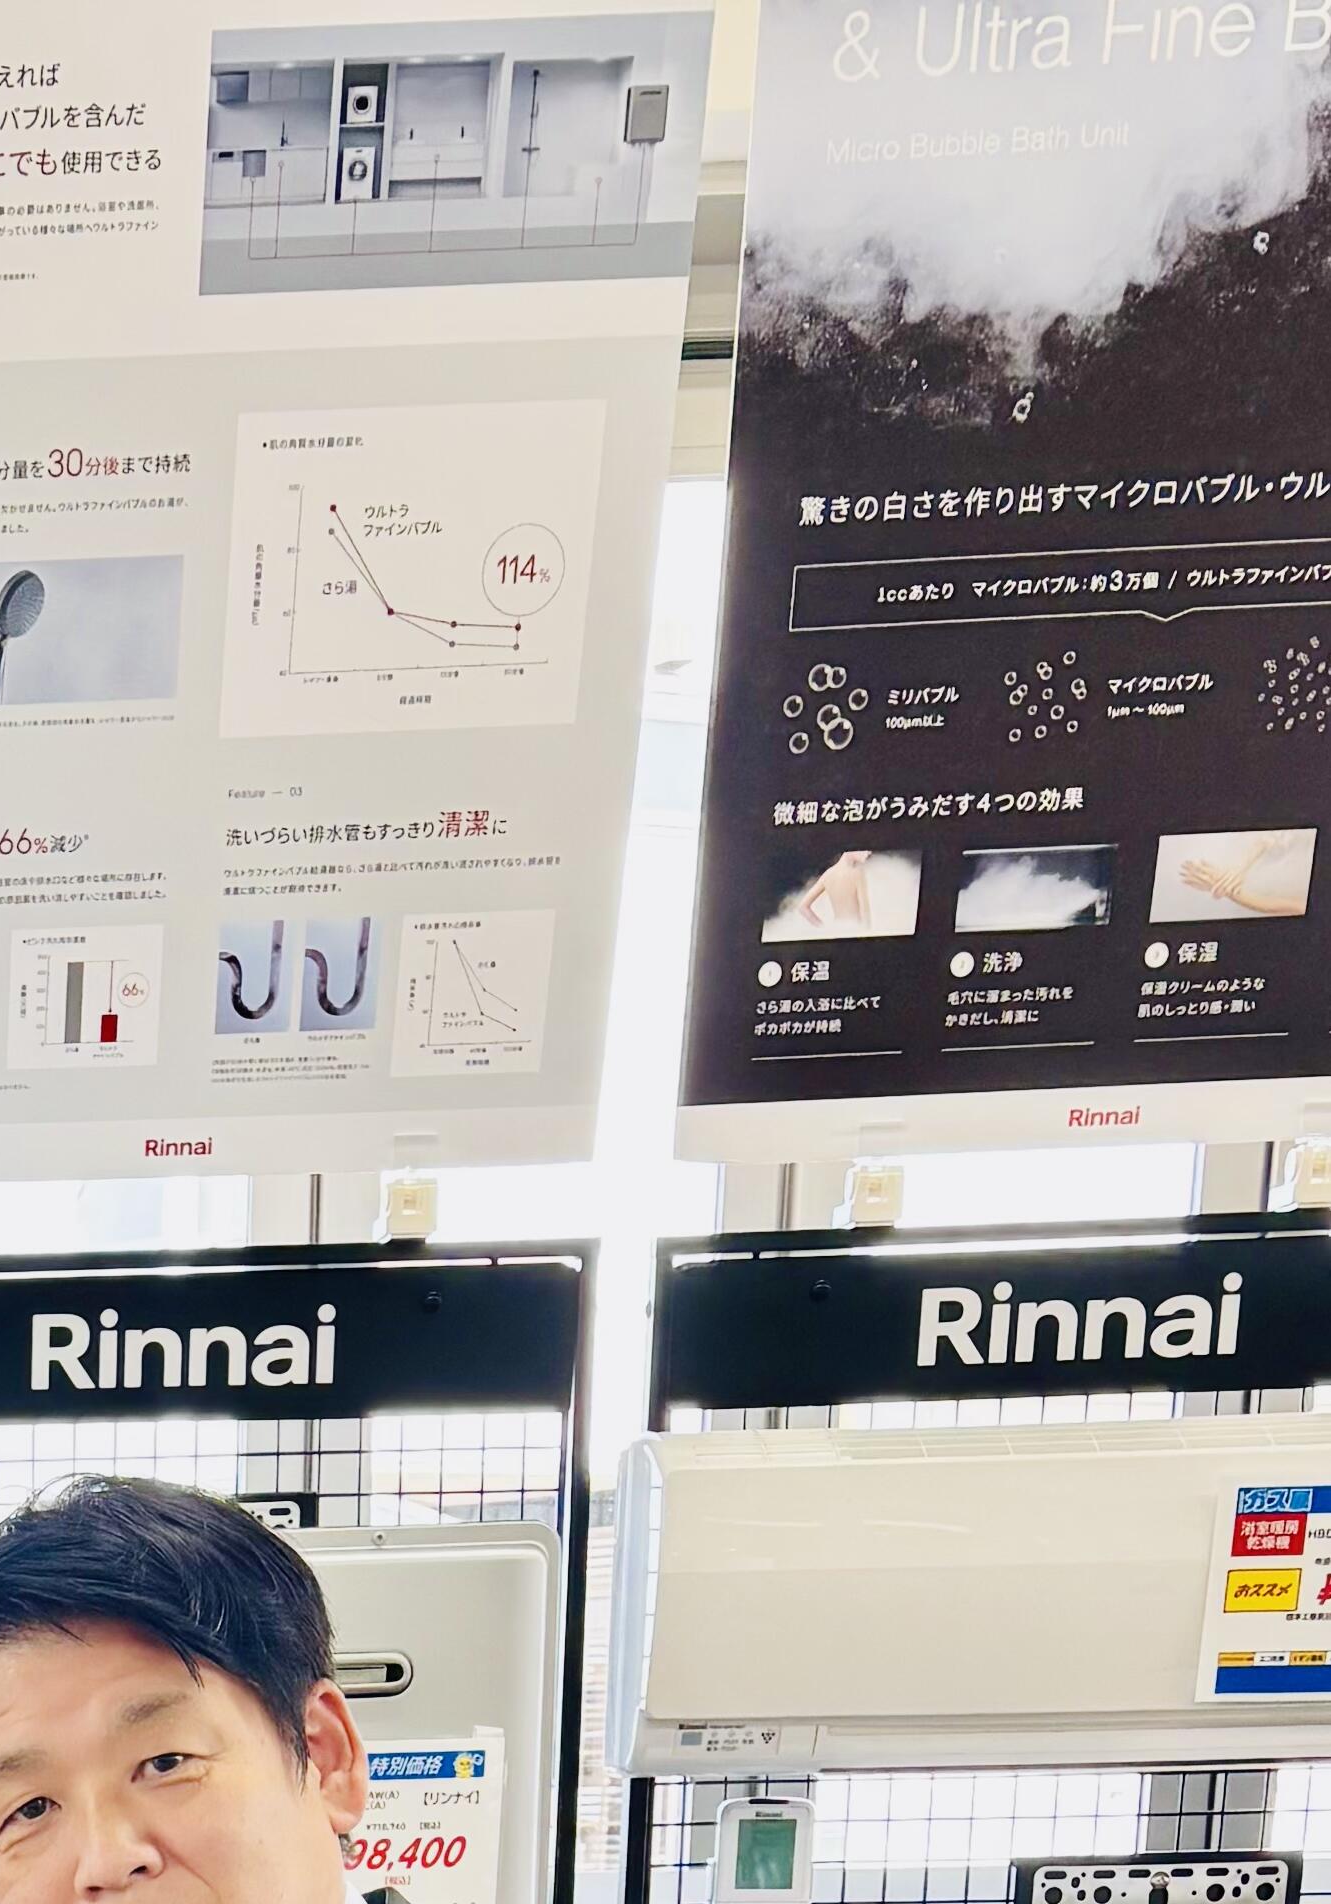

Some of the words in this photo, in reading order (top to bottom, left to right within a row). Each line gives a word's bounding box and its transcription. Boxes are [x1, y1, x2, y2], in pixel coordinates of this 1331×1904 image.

[833, 10, 881, 82] &
[914, 3, 1072, 77] Ultra
[827, 139, 900, 164] Micro
[910, 130, 1001, 159] Bubble
[1012, 125, 1071, 154] Bath
[1081, 120, 1130, 148] Unit
[364, 503, 409, 519] ウルトラ
[363, 521, 443, 538] ファインバブル
[496, 554, 551, 585] 114%
[887, 686, 960, 705] ミリバブル
[1107, 672, 1214, 695] マイクロバブル
[772, 787, 1085, 826] 微細な泡がうみだす4つの効果
[225, 810, 508, 847] 洗いづらい排水管もすっきり清潔に
[982, 951, 1023, 974] 洗浄
[1177, 941, 1219, 964] 保湿
[790, 959, 831, 983] 保温
[1068, 1104, 1141, 1129] Rinnai
[144, 1136, 213, 1160] Rinnai
[916, 1271, 1243, 1368] Rinnai
[30, 1303, 337, 1391] Rinnai
[1234, 1582, 1294, 1599] おススメ
[370, 1755, 443, 1777] 特別価格
[423, 1790, 480, 1806] 【リンナイ】
